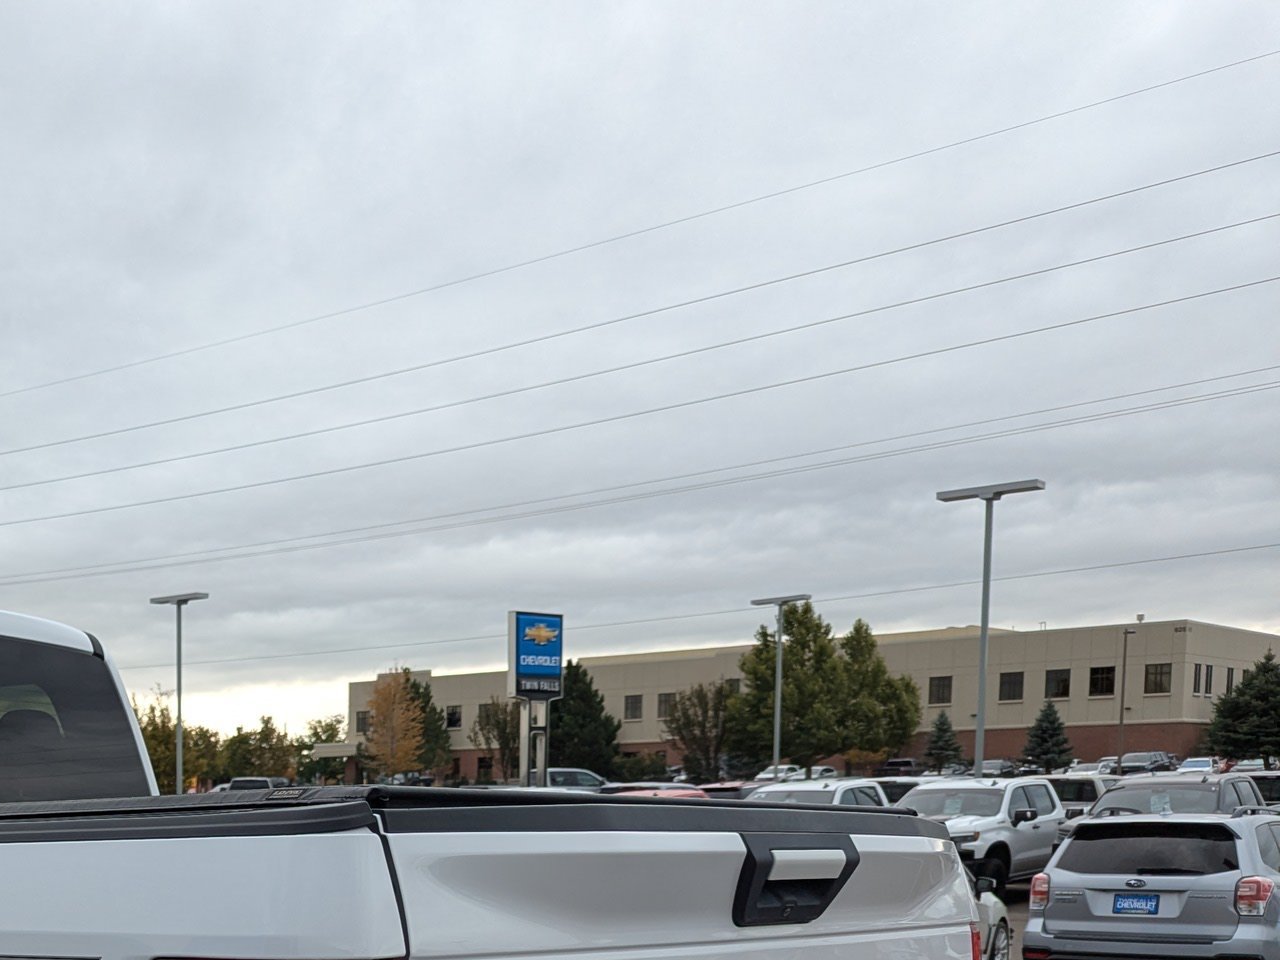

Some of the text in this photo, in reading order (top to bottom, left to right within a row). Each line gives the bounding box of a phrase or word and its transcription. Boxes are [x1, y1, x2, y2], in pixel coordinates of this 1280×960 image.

[520, 655, 561, 667] CHEVROLET
[521, 680, 560, 692] TWIN FALLS
